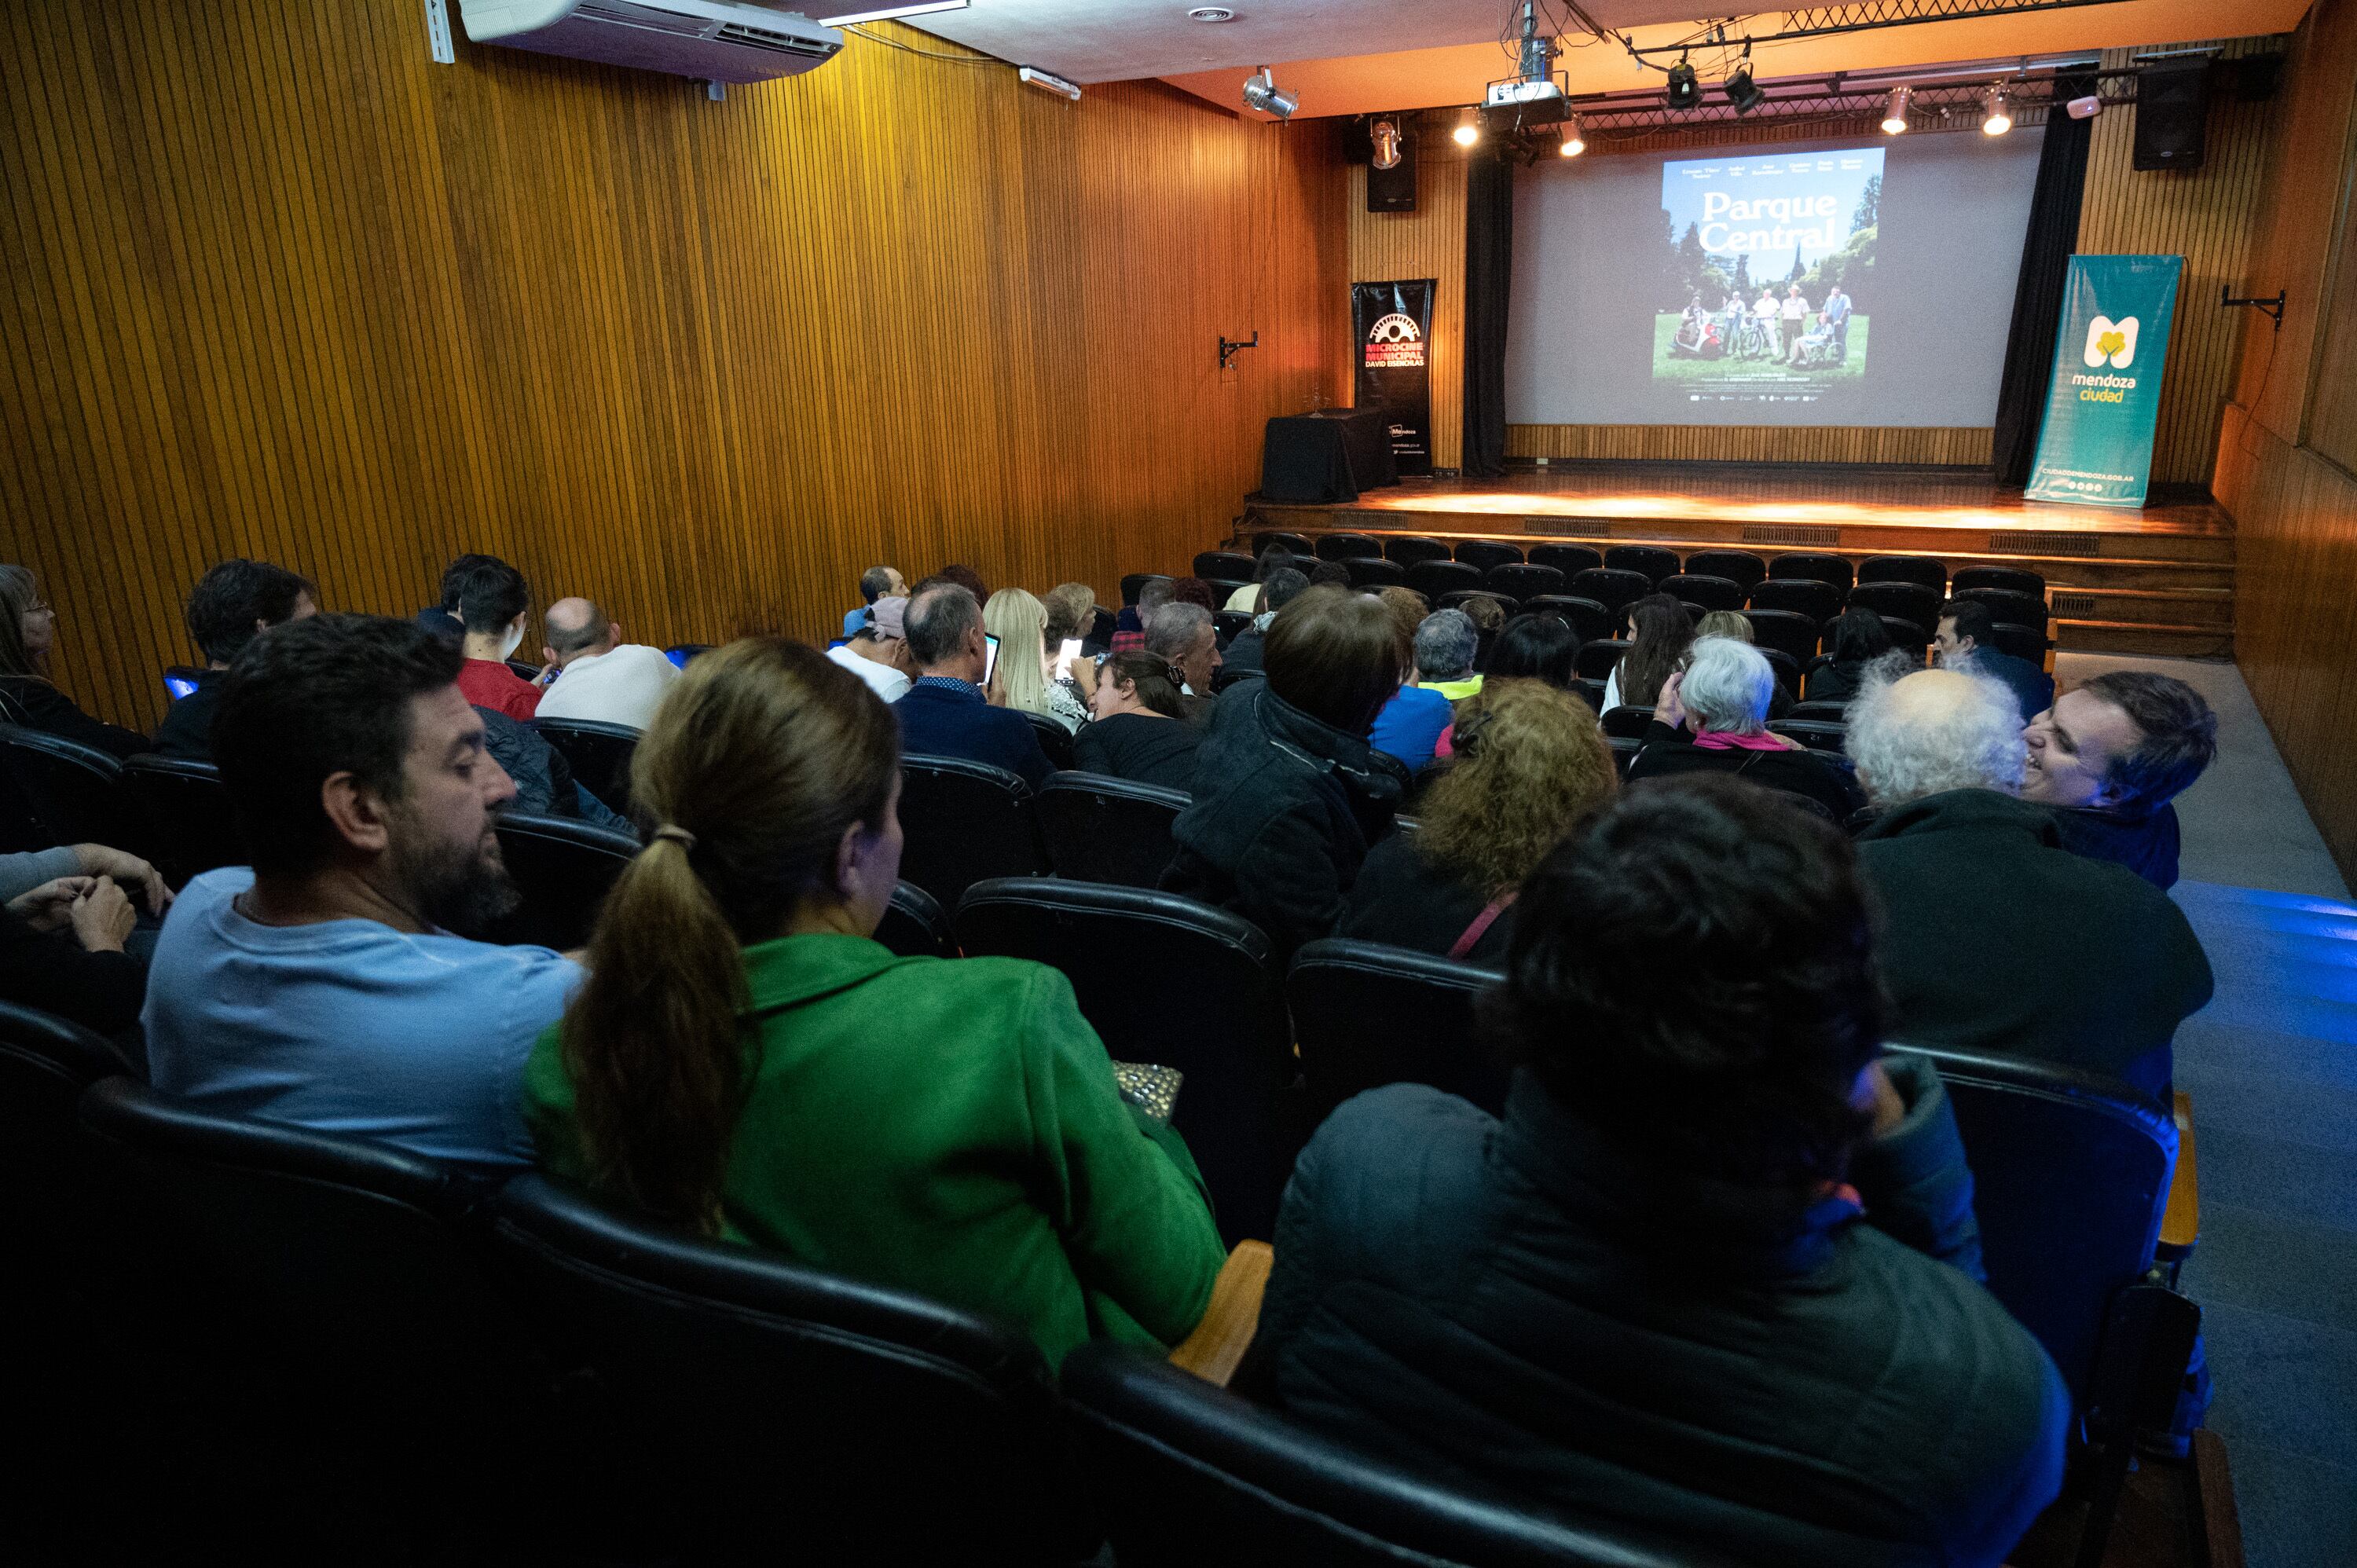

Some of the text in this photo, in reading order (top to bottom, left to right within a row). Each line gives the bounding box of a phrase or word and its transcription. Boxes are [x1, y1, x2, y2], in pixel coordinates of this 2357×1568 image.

[1703, 192, 1838, 223] Parque
[1699, 217, 1836, 252] Central
[1365, 343, 1424, 352] MICROCINE
[1365, 351, 1424, 361] MUNICIPAL
[2073, 373, 2136, 389] mendoza
[2080, 387, 2124, 404] ciudad
